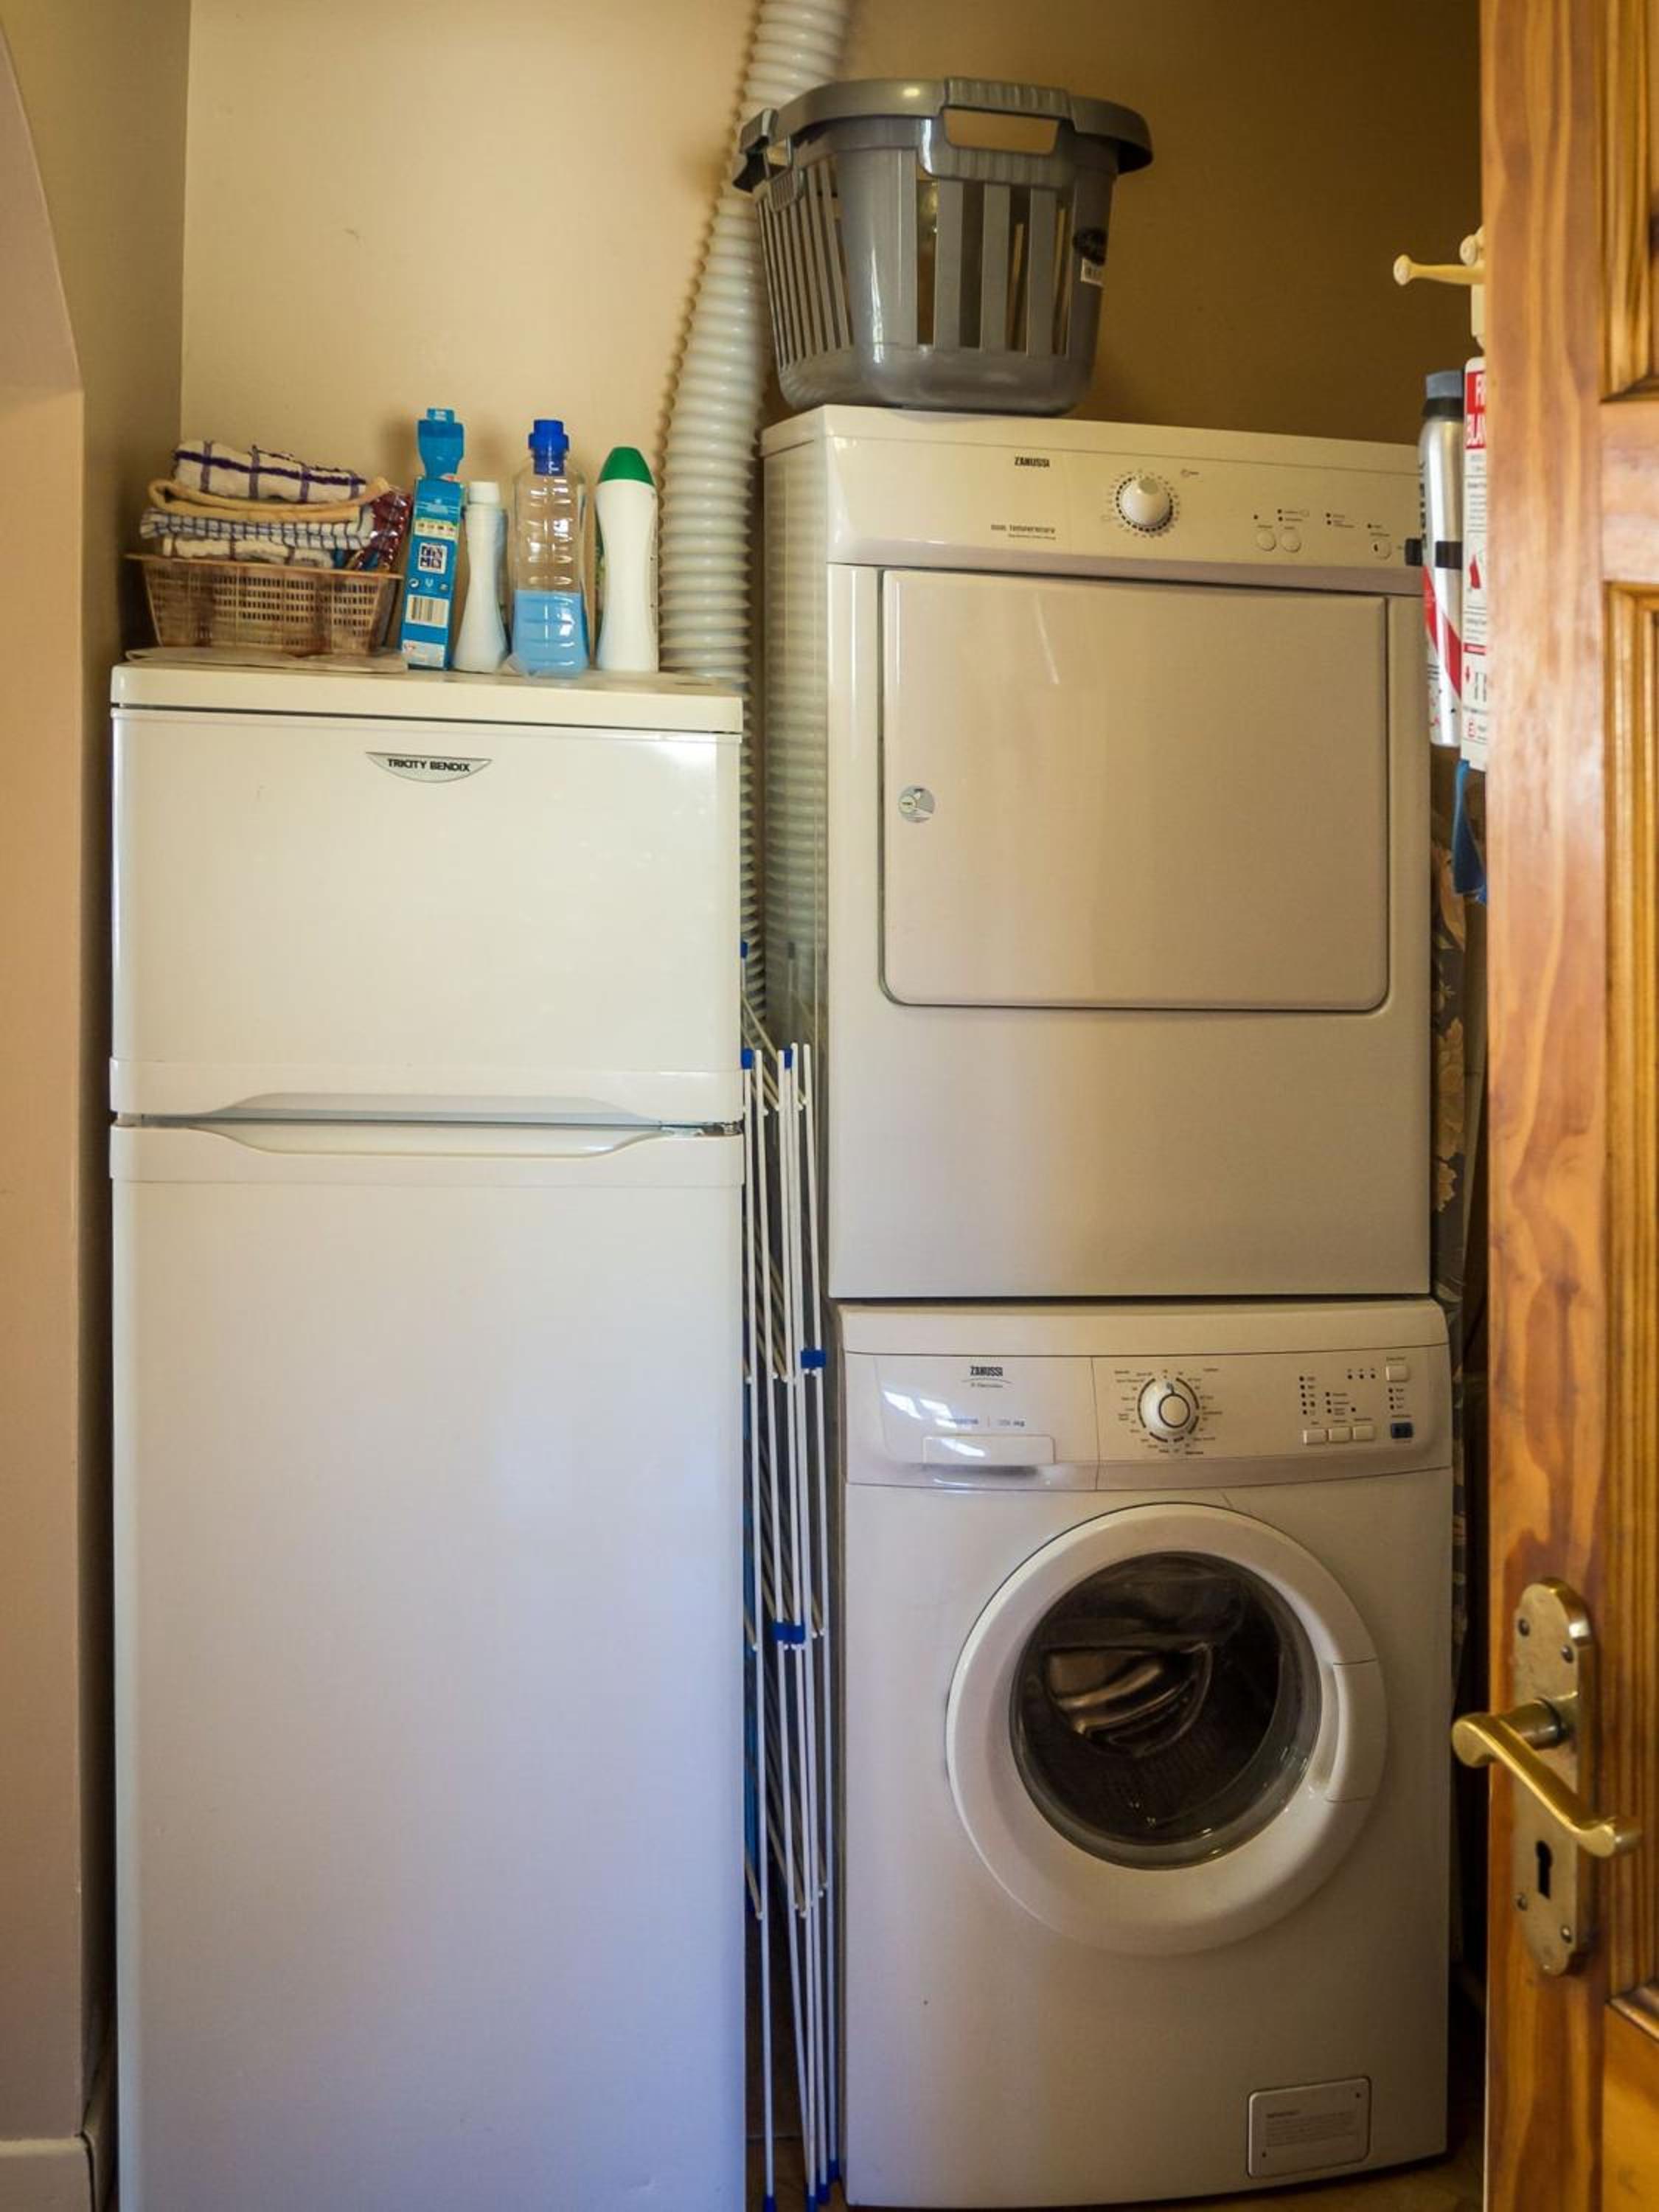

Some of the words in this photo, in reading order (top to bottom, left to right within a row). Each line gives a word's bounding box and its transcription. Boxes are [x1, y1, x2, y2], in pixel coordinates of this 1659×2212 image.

[388, 758, 427, 769] TRICITY
[430, 761, 470, 772] BENDIX
[970, 1366, 1004, 1377] ZANUSSI
